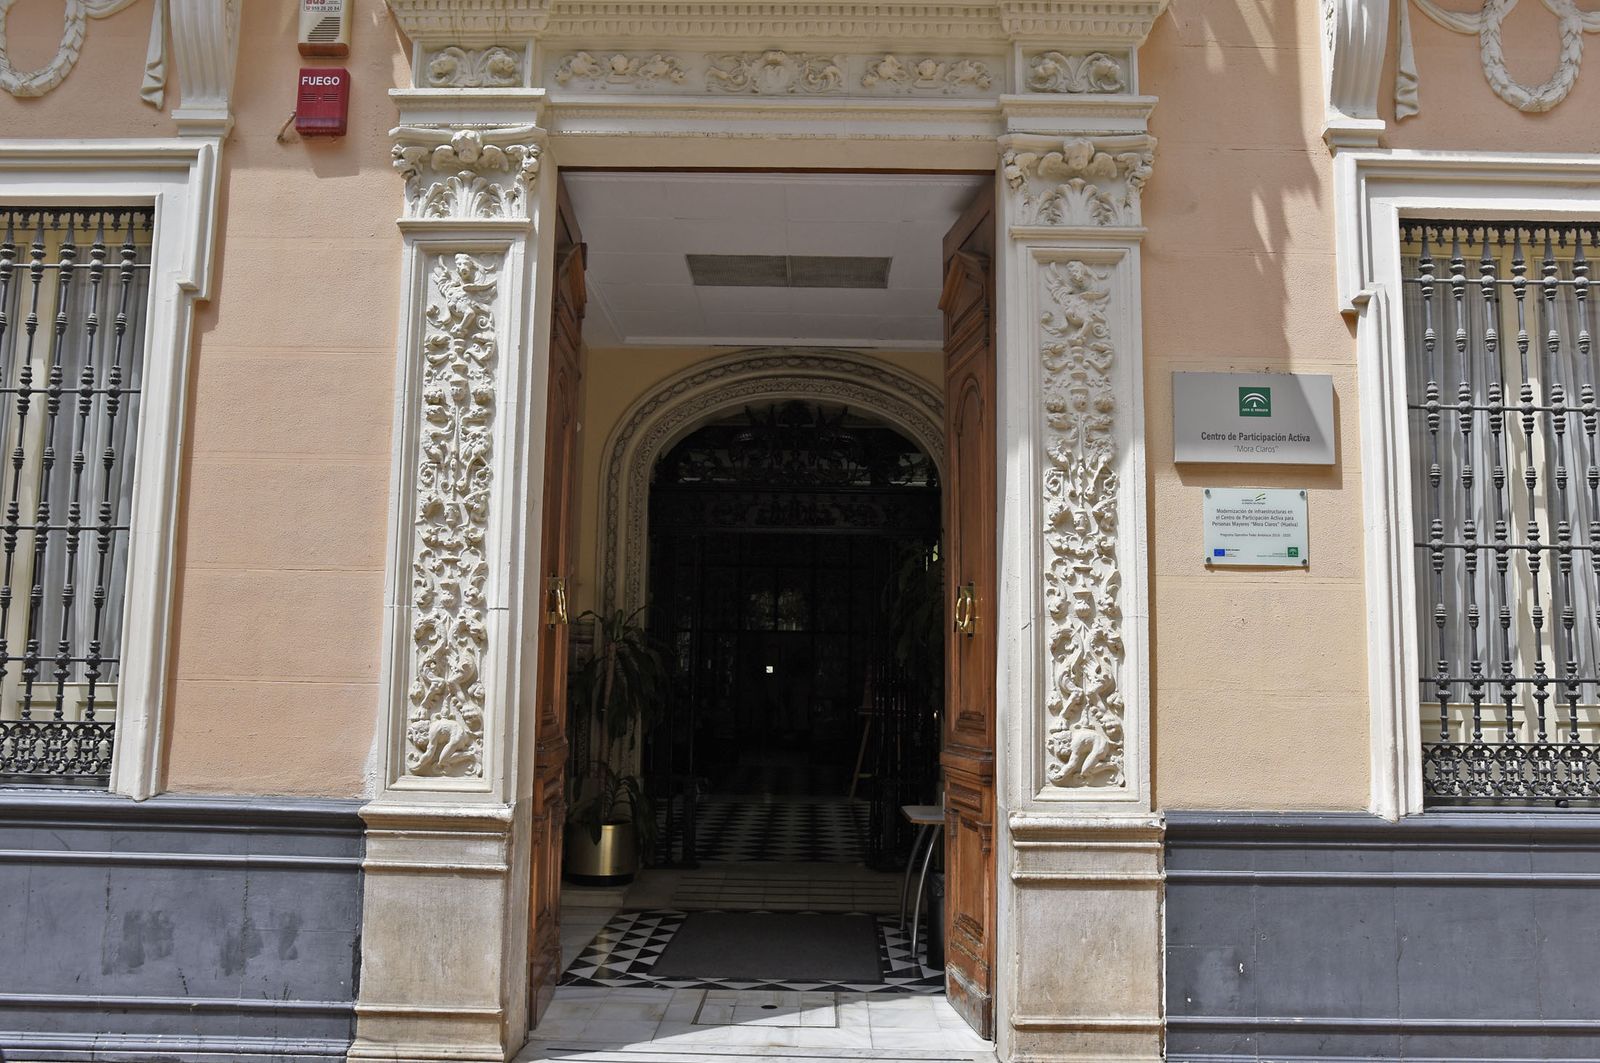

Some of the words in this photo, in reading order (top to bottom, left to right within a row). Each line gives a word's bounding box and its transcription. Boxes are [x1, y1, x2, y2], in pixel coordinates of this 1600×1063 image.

[302, 76, 340, 86] FUEGO
[1201, 431, 1226, 441] Centro
[1227, 432, 1237, 441] de
[1238, 432, 1287, 443] Participación
[1288, 433, 1311, 442] Activa
